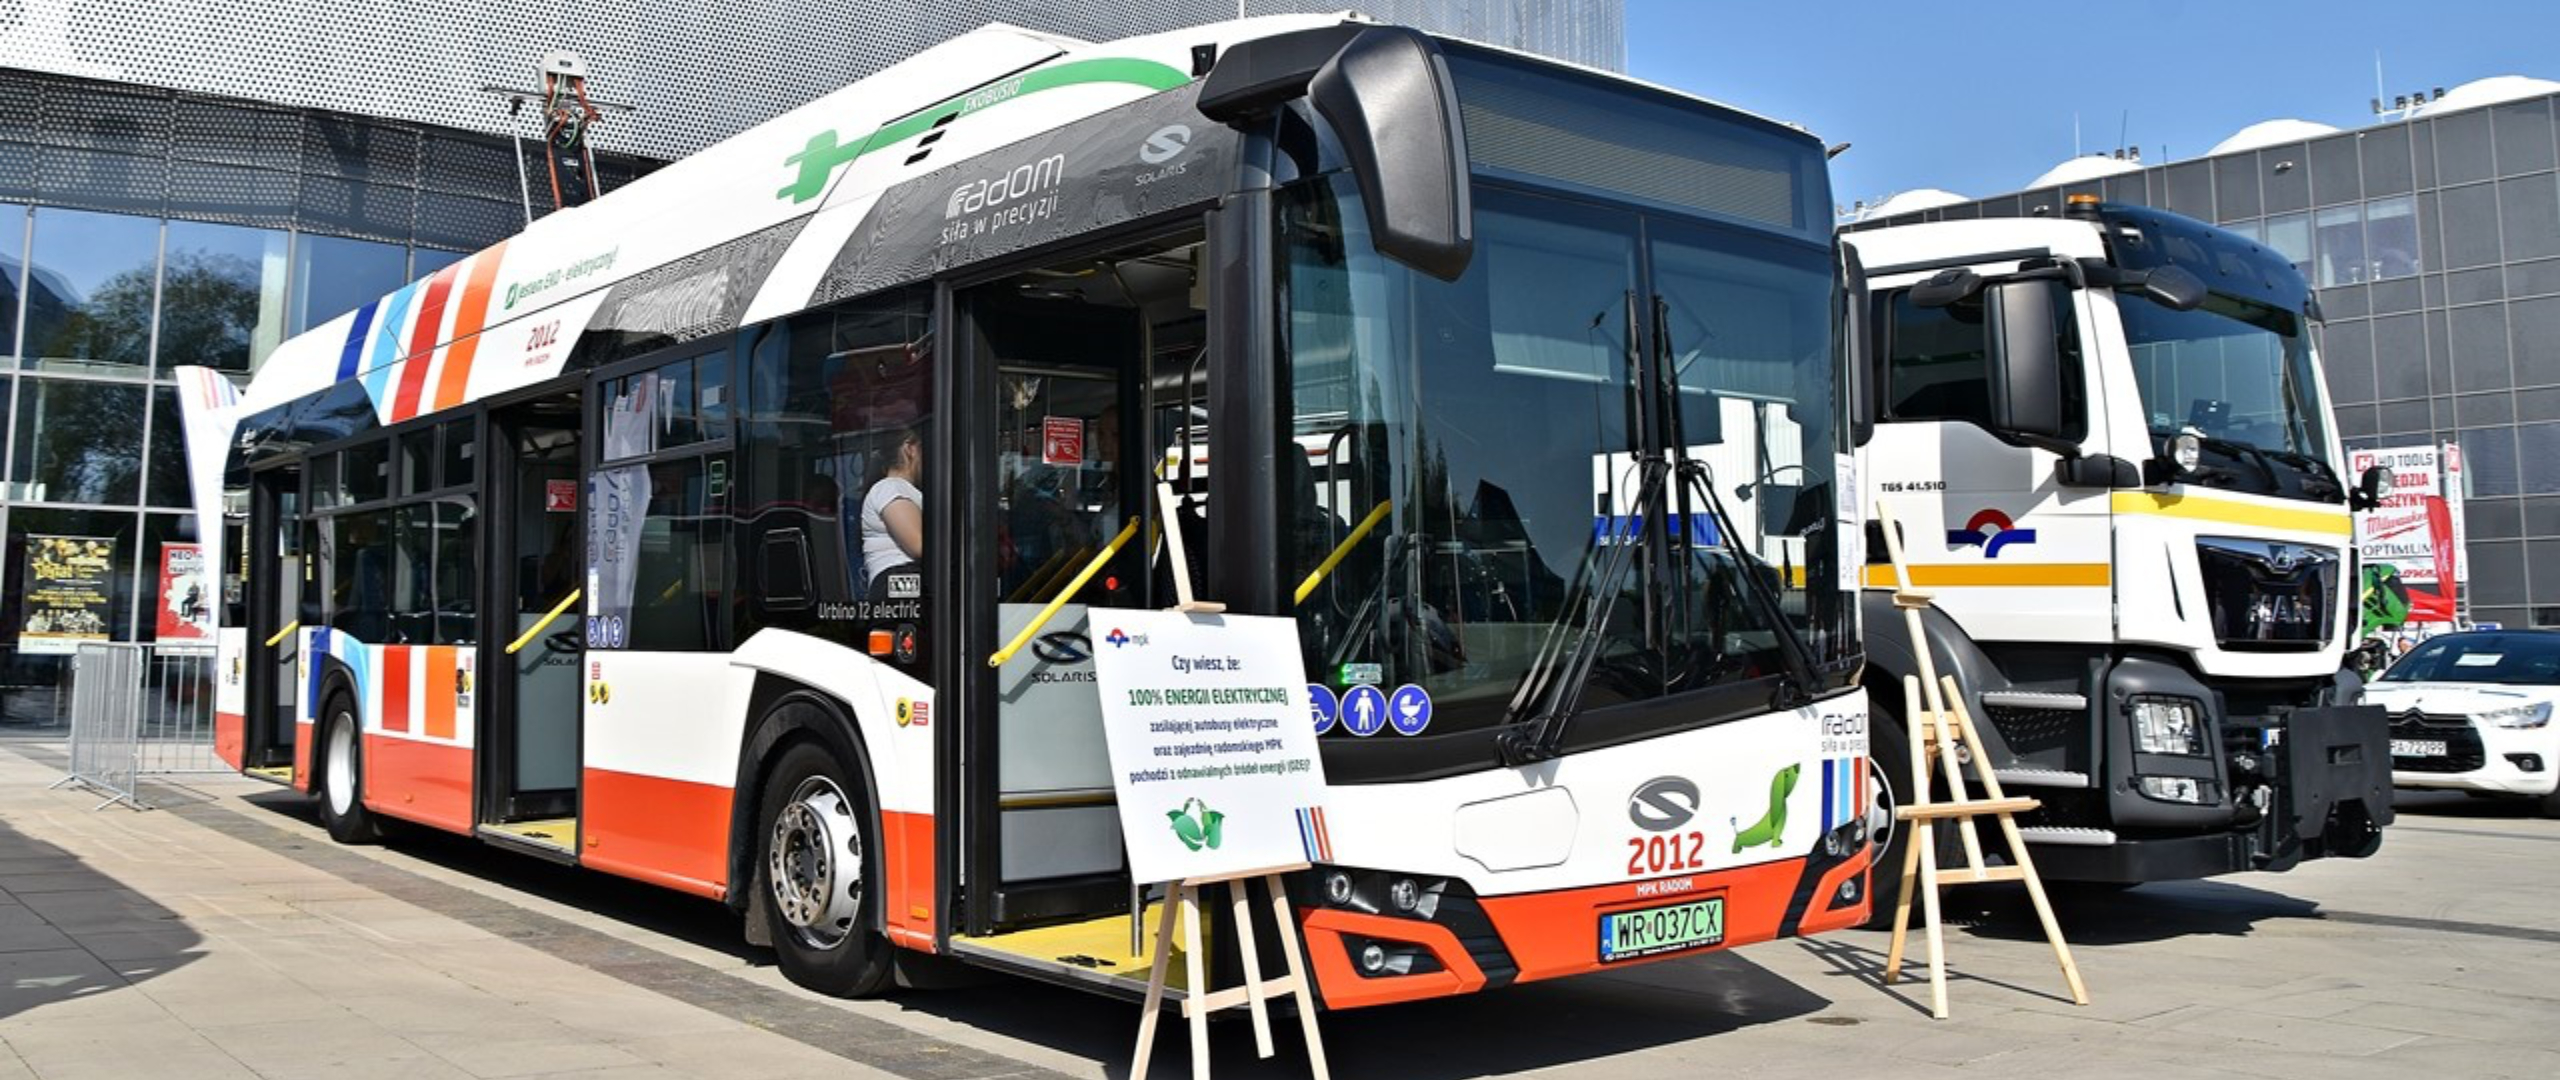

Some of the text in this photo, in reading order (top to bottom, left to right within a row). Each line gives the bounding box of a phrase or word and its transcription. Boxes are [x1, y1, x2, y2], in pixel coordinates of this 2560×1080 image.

[1135, 163, 1187, 187] SOLARIS
[941, 189, 1059, 245] siła w precyzji
[526, 319, 561, 352] 2012
[2397, 453, 2434, 467] TOOLS
[1881, 481, 1946, 492] TGS 41.510
[818, 600, 921, 619] Urbino 12 electric
[2249, 594, 2312, 622] MAN
[1132, 634, 1149, 647] mpk
[1172, 655, 1241, 673] Czy wiesz, że:
[1031, 671, 1097, 683] SOLARIS
[1128, 687, 1289, 706] 100% ENERGII ELEKTRYCZNEJ
[1195, 718, 1232, 733] autobusy
[1233, 717, 1278, 733] elektryczne
[1130, 769, 1168, 785] pochodzi
[1627, 831, 1705, 875] 2012
[1618, 914, 1646, 948] WR
[1653, 903, 1718, 942] 037CX
